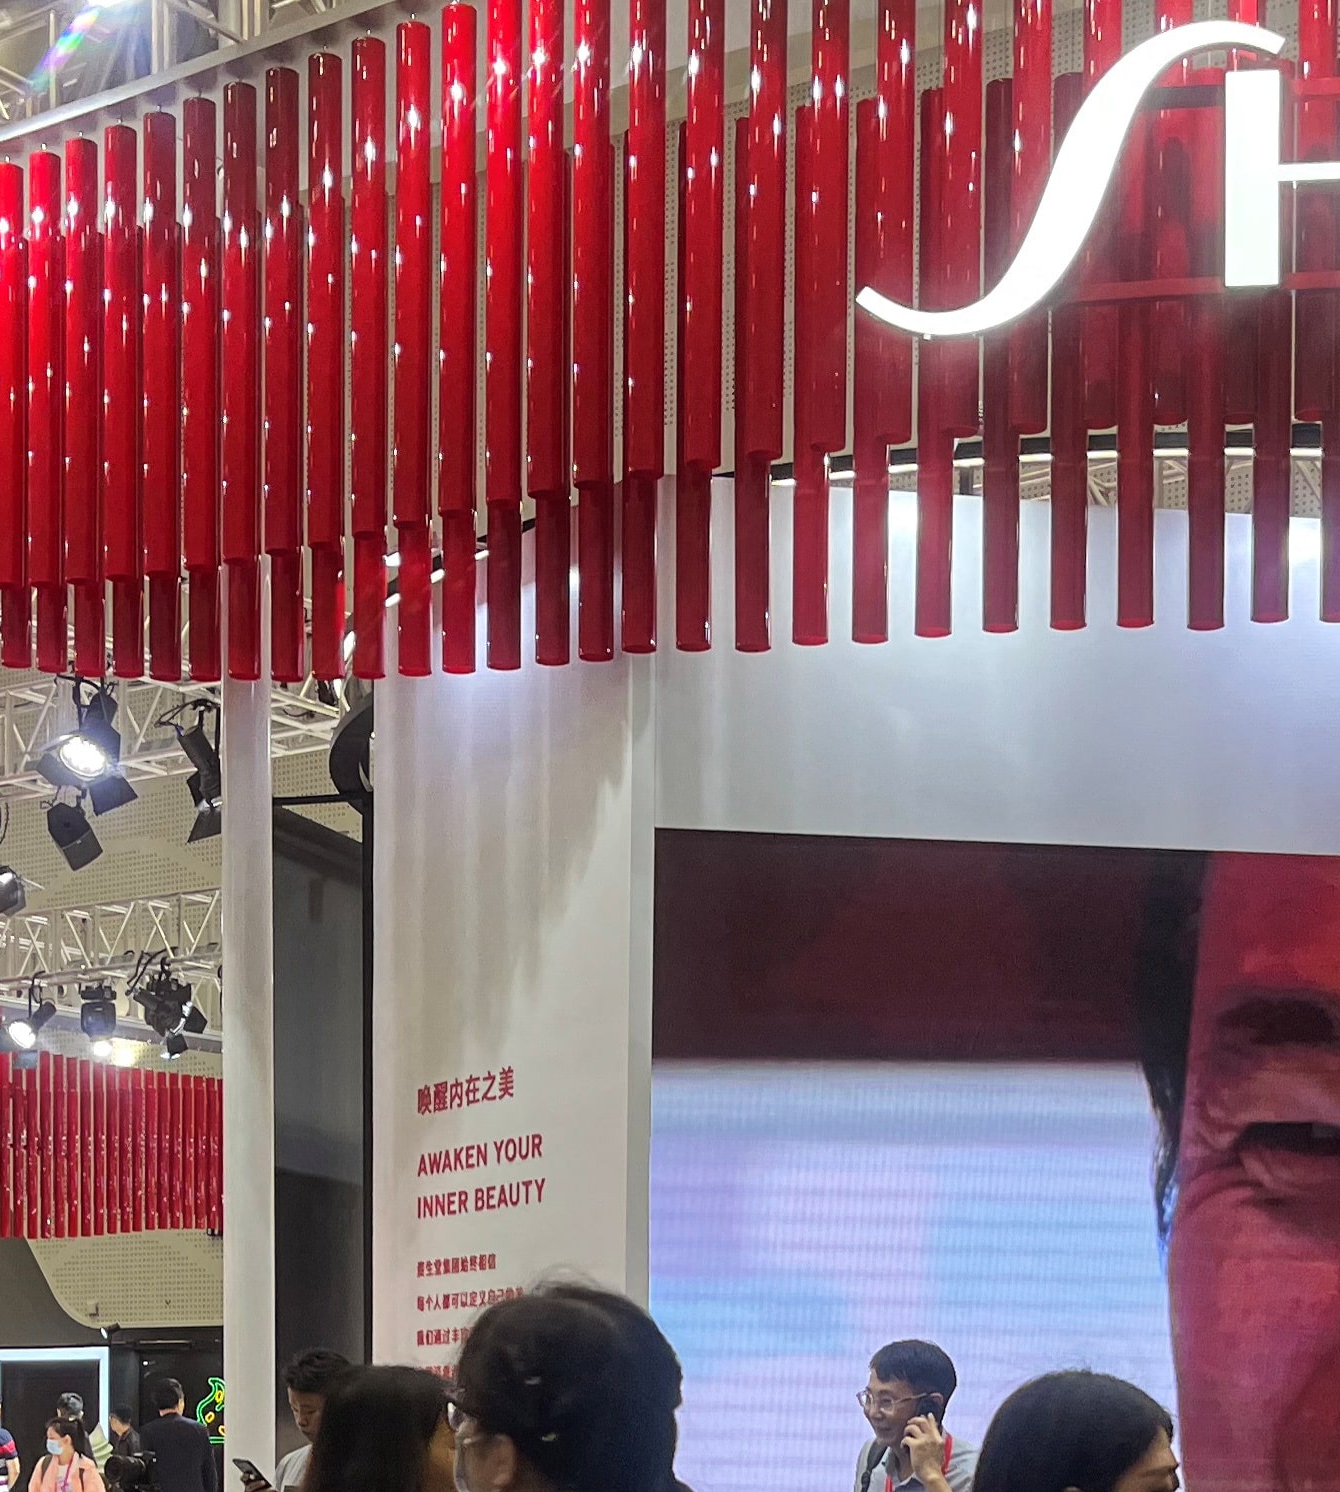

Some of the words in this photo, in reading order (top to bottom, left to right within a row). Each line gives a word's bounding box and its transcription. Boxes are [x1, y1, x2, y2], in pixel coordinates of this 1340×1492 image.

[416, 1065, 516, 1116] 唤醒内在之美
[416, 1142, 489, 1178] AWAKEN
[493, 1133, 544, 1165] YOUR
[416, 1190, 469, 1220] INNER
[473, 1178, 547, 1213] BEAUTY
